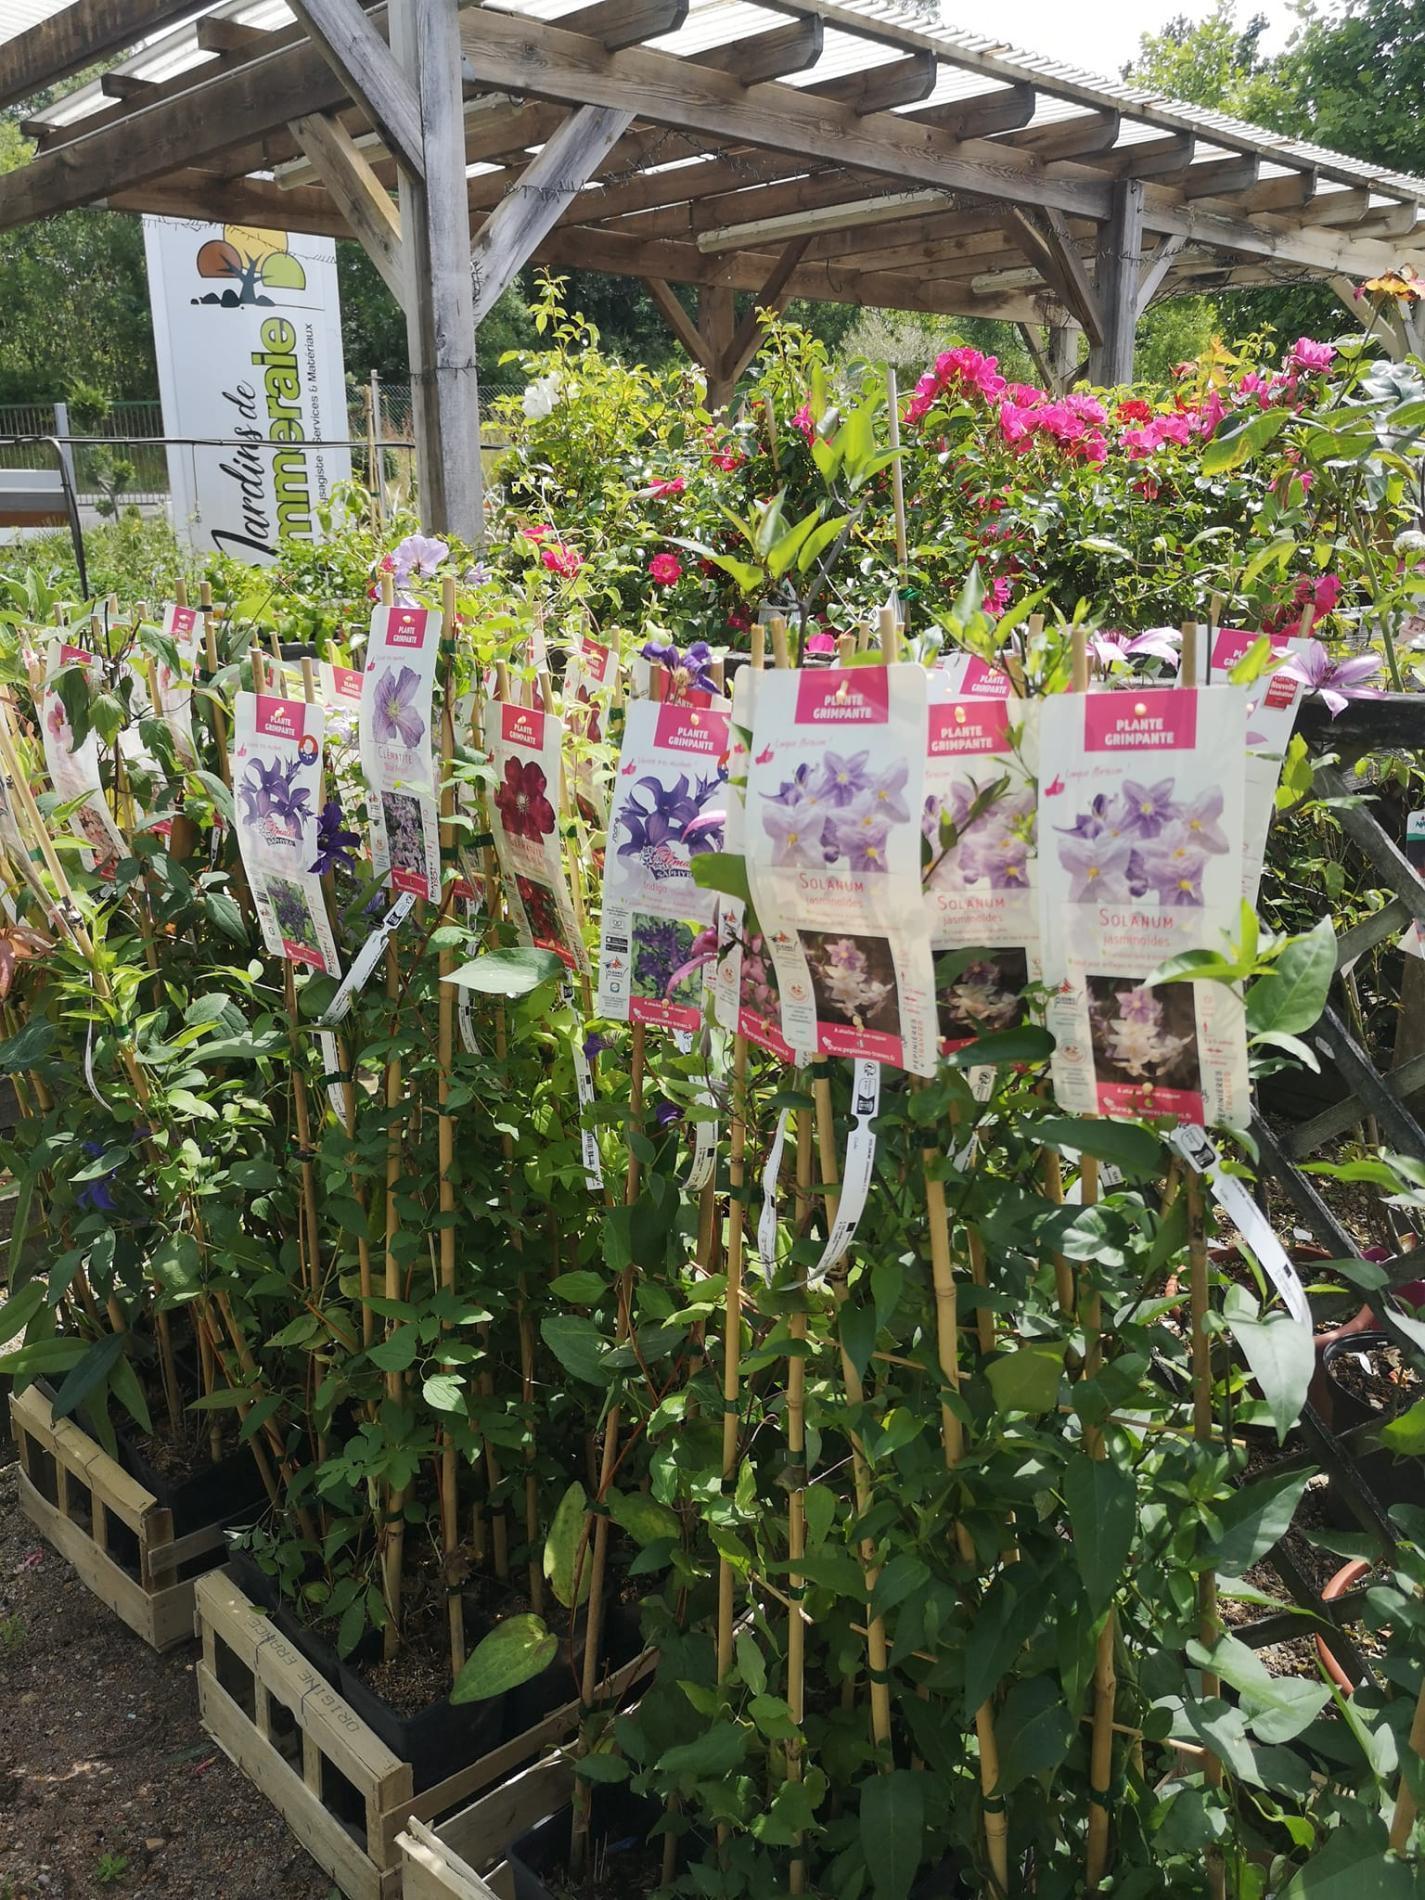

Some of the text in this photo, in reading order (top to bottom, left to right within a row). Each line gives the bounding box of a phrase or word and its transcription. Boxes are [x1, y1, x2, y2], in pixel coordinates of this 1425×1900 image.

[304, 322, 317, 384] Matériaux
[310, 394, 323, 443] Services
[211, 380, 280, 558] Jardins de
[812, 706, 872, 719] GRIMPANTE
[940, 725, 983, 739] PLANTE
[1116, 718, 1164, 731] PLANTE
[677, 727, 709, 739] PLANTE
[1104, 731, 1175, 746] GRIMPANTE
[668, 737, 714, 751] GRIMPANTE
[931, 737, 993, 752] GRIMPANTE
[799, 872, 865, 893] SOLANUM
[937, 895, 1006, 911] SOLANUM
[1099, 907, 1174, 929] SOLANUM
